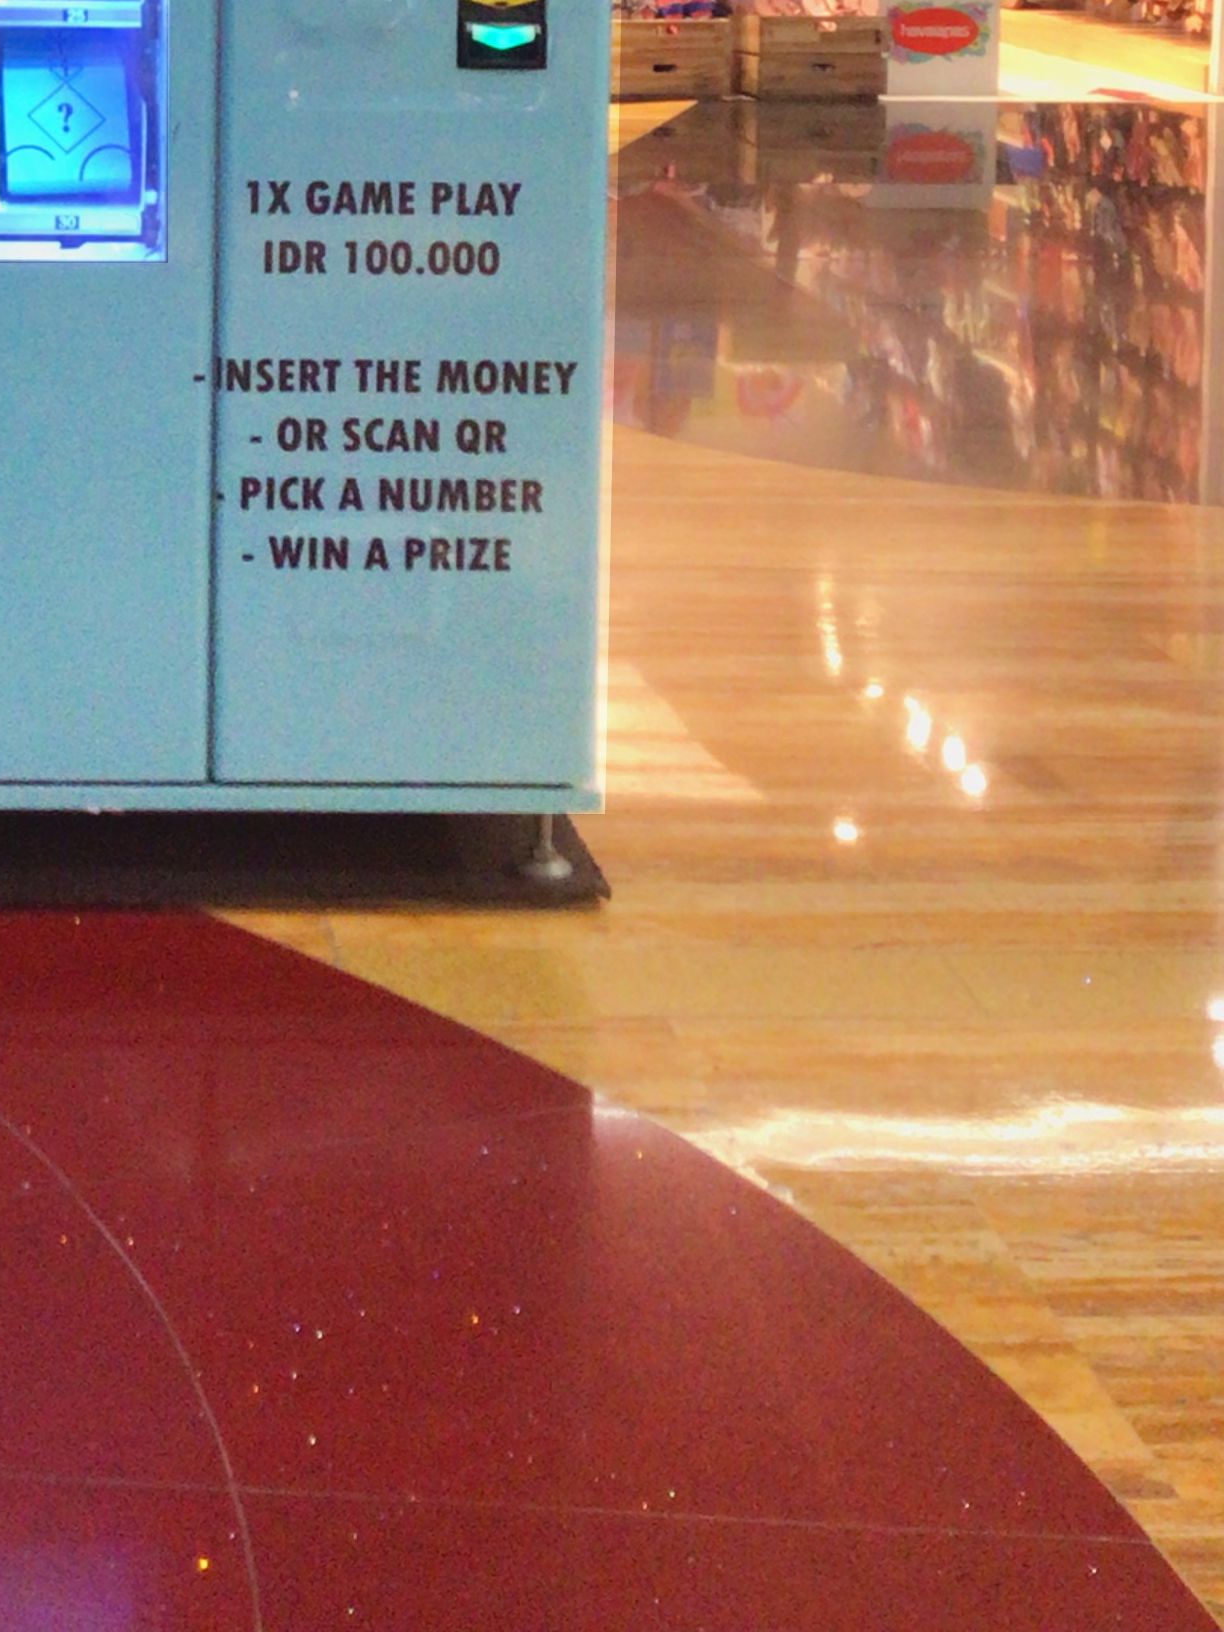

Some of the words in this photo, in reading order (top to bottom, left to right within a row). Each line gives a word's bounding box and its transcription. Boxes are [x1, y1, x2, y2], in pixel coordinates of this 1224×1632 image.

[246, 180, 291, 215] 1X
[305, 181, 416, 216] GAME
[430, 182, 522, 216] PLAY
[264, 240, 327, 274] IDR
[345, 240, 501, 275] 100.000
[354, 359, 422, 393] THE
[436, 359, 577, 395] MONEY
[277, 417, 328, 452] OR
[343, 418, 440, 453] SCAN
[455, 419, 507, 455] QR
[240, 476, 325, 511] PICK
[338, 478, 365, 511] A
[379, 478, 544, 513] NUMBER
[268, 535, 349, 570] WIN
[364, 537, 390, 571] A
[405, 537, 512, 572] PRIZE
